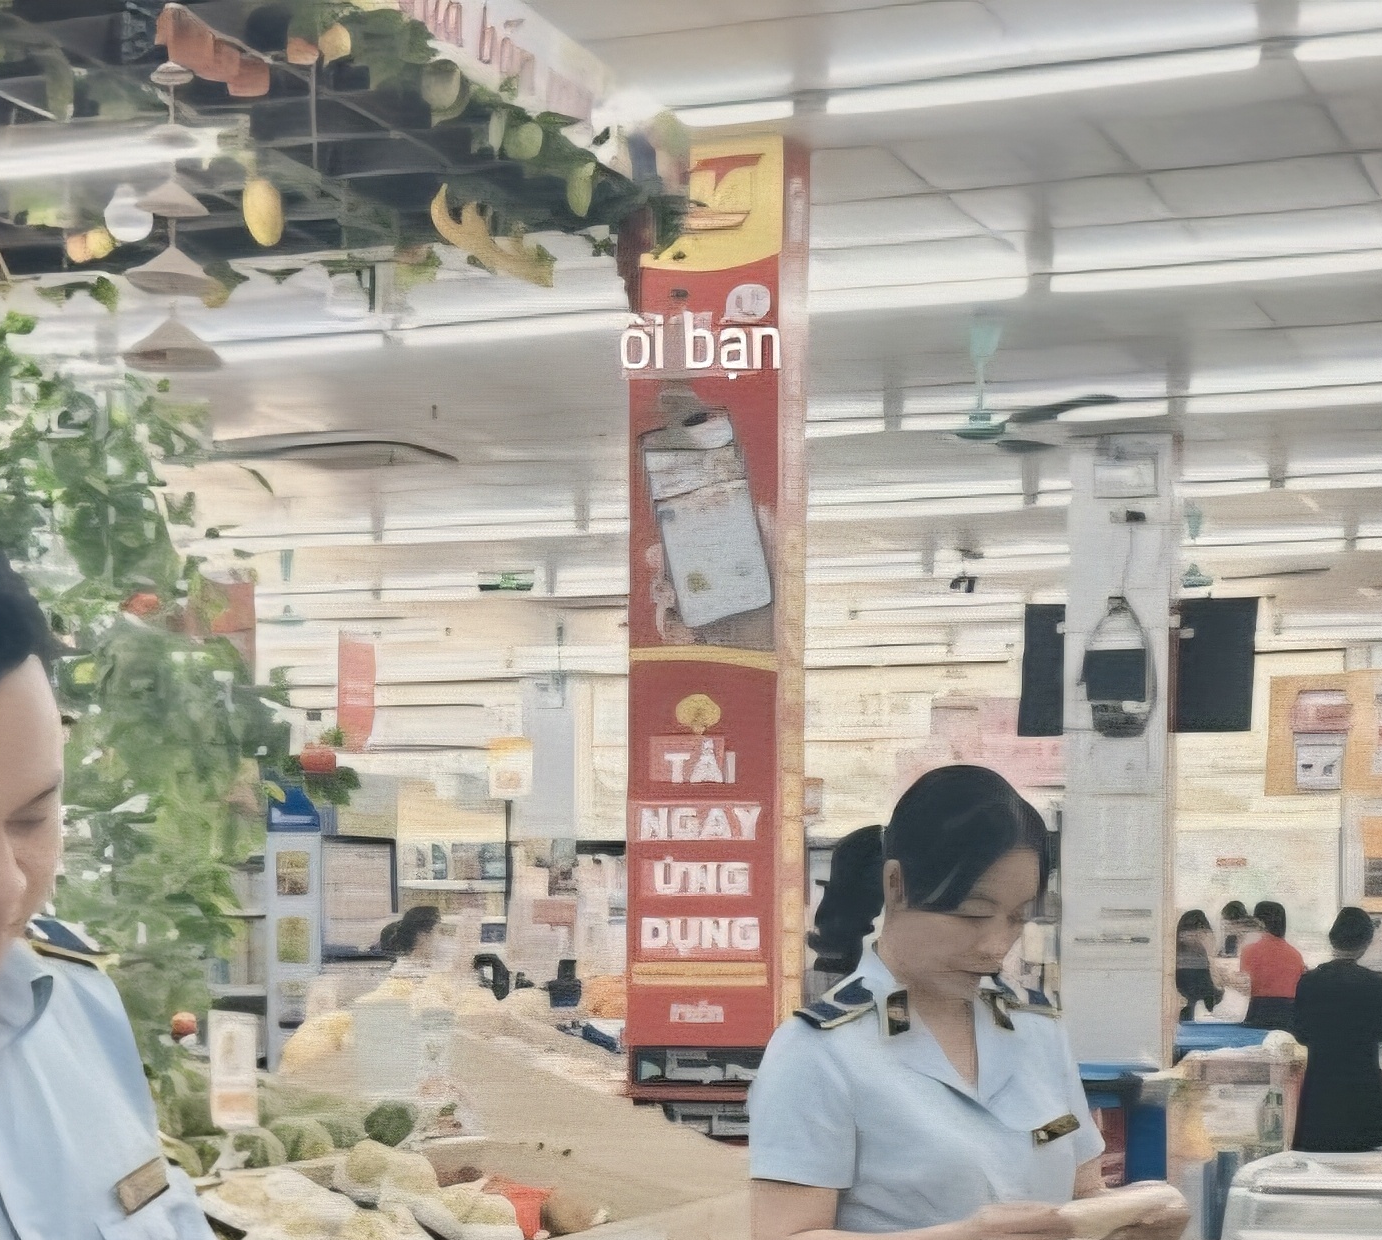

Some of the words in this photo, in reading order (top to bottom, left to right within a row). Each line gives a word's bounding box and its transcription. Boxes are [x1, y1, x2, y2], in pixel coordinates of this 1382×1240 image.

[664, 737, 736, 784] TẢI
[640, 806, 762, 841] NGAY
[640, 916, 760, 957] DỤNG
